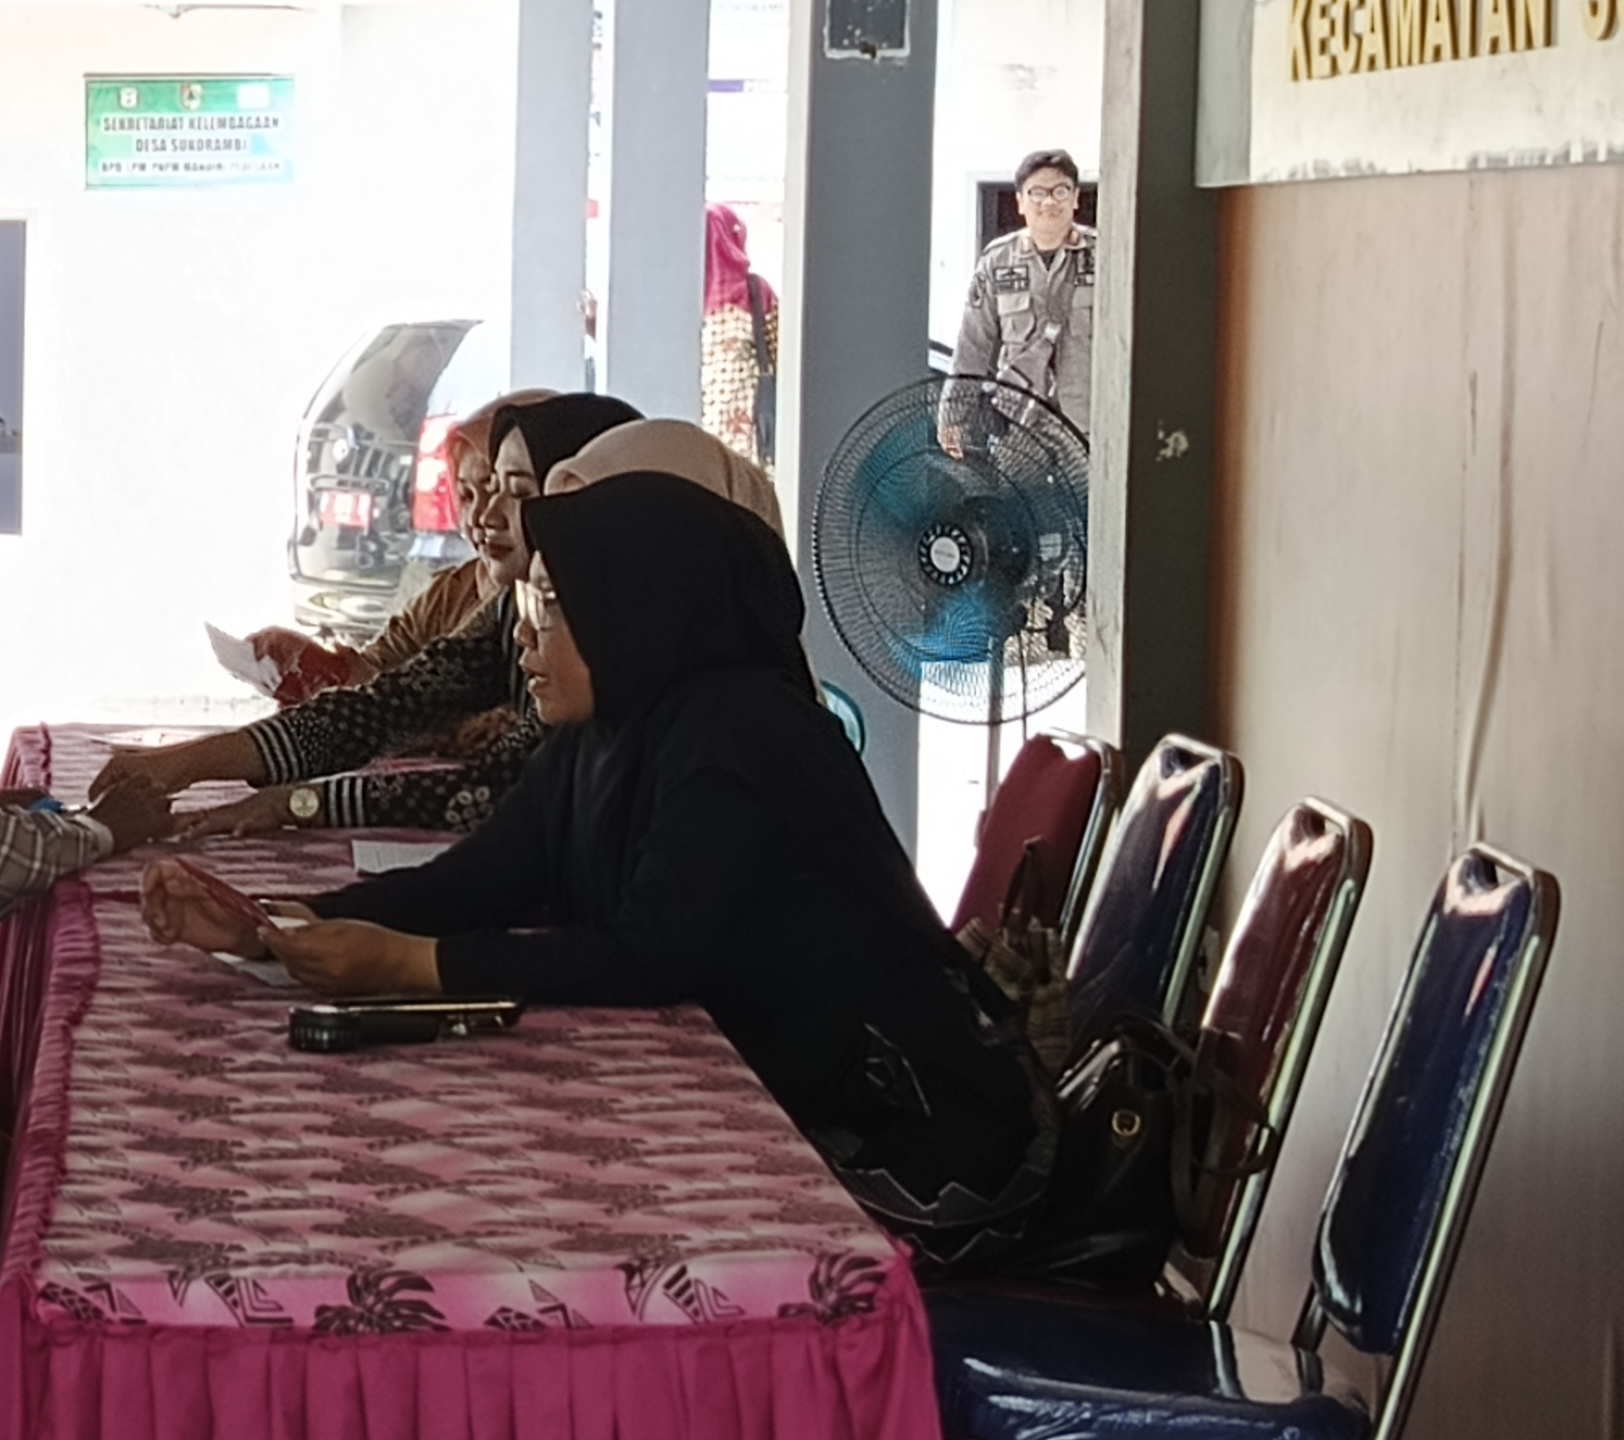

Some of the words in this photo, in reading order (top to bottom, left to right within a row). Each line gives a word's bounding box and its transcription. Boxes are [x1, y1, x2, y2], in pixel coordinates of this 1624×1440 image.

[1287, 0, 1554, 81] KECAMATAN
[103, 116, 184, 132] SEKRETARIAT
[188, 115, 279, 131] KELEMBAGAAN
[135, 138, 167, 153] DESA
[171, 138, 247, 152] SUKORAMBI
